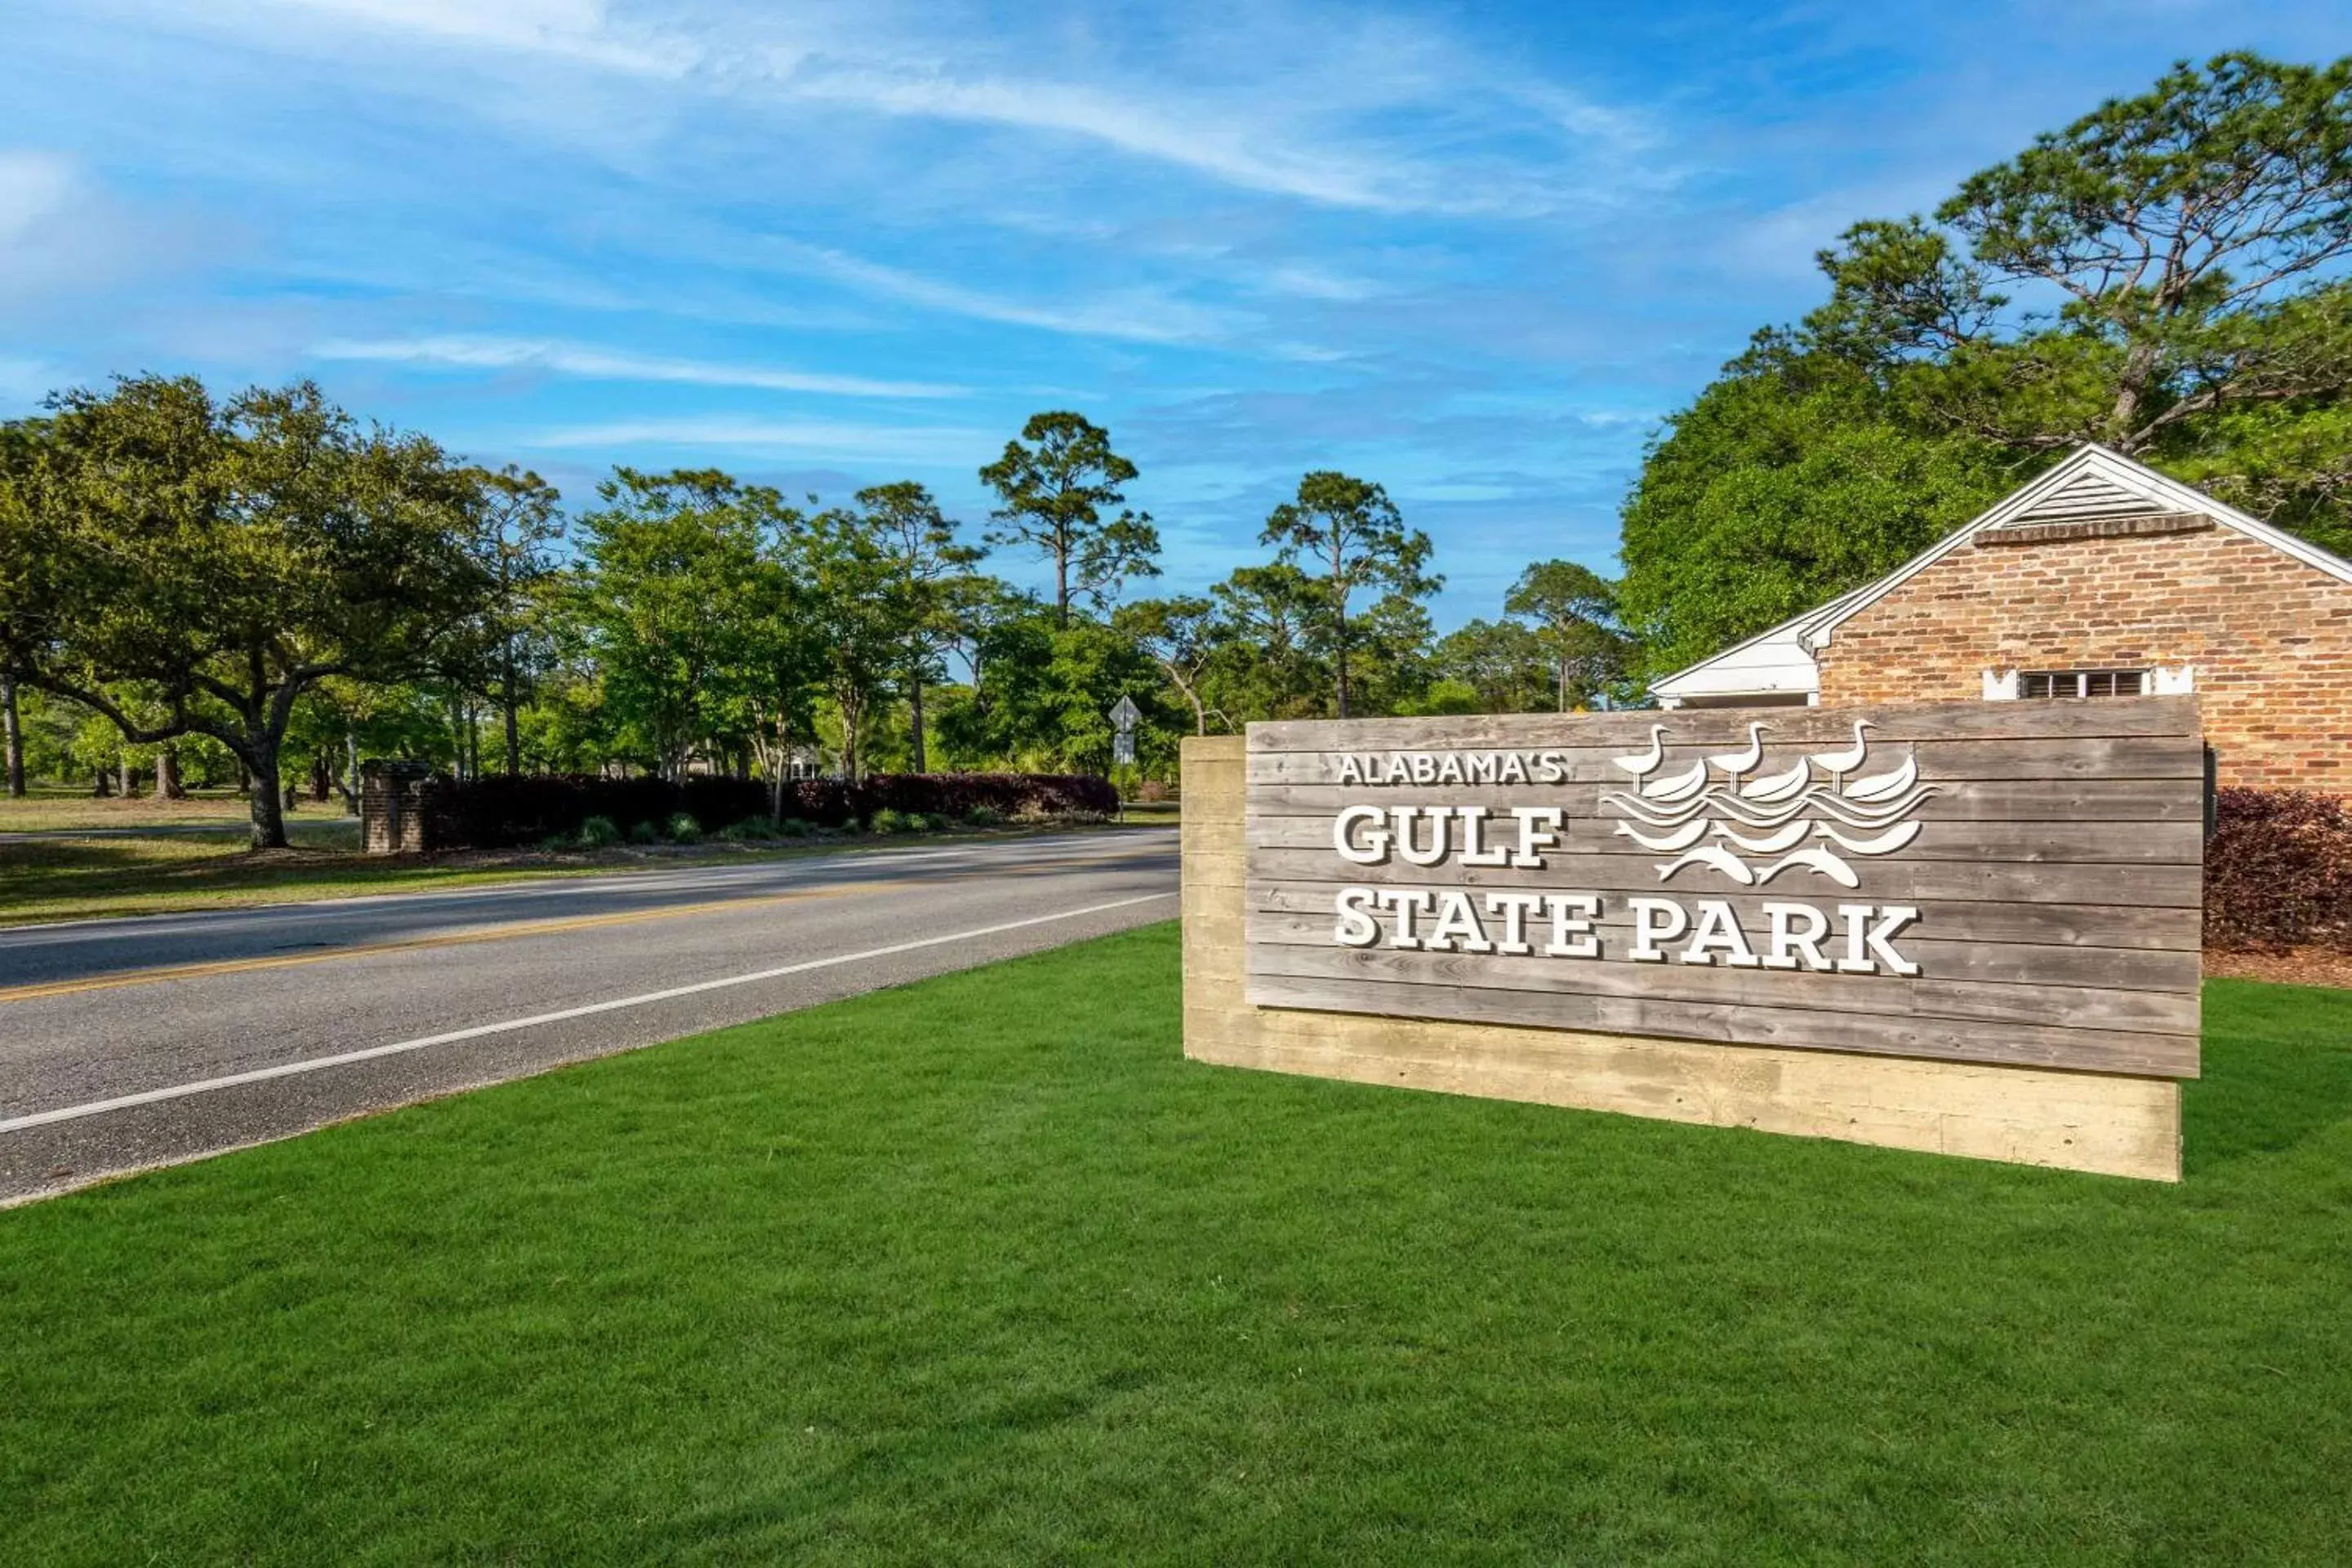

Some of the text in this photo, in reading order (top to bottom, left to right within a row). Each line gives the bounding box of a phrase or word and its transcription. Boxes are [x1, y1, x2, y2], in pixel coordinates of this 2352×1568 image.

[1339, 751, 1566, 784] ALABAMA'S
[1334, 804, 1563, 868] GULF
[1334, 887, 1922, 976] STATE PARK
